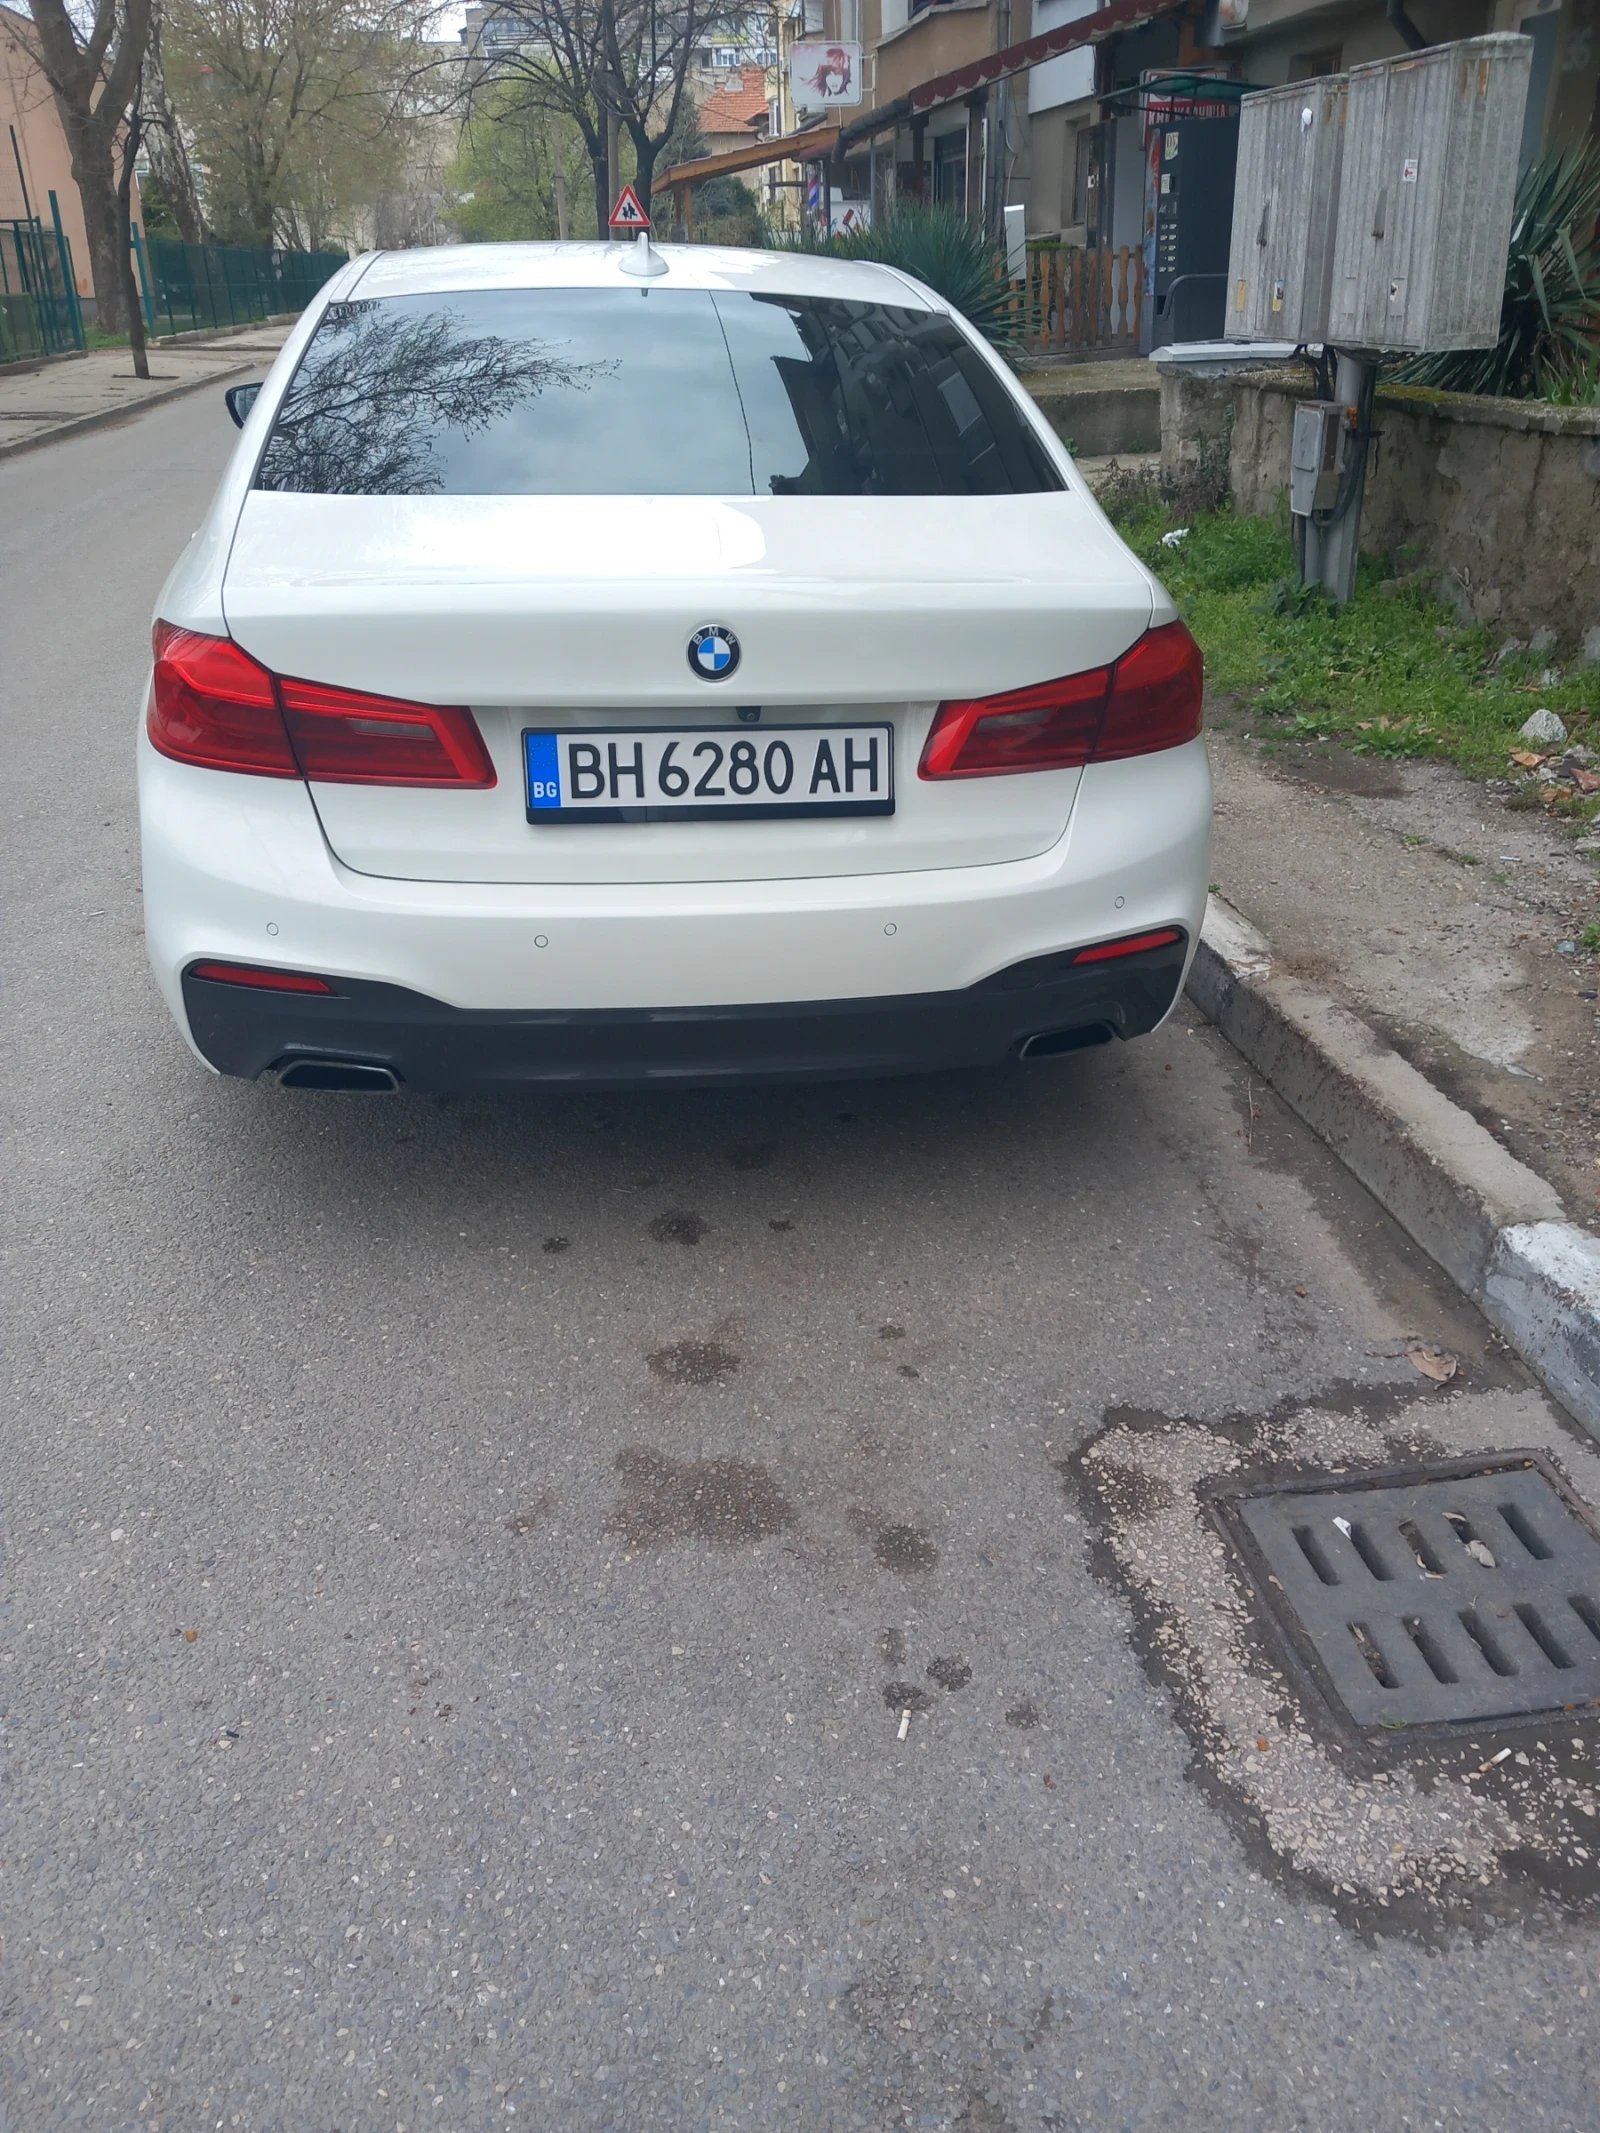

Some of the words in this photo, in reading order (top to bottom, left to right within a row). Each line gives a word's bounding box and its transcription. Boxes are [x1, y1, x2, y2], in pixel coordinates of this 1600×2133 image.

[692, 626, 736, 645] BMW
[569, 742, 645, 799] BH
[658, 740, 794, 798] 6280
[809, 737, 878, 794] AH
[533, 781, 558, 799] BG
